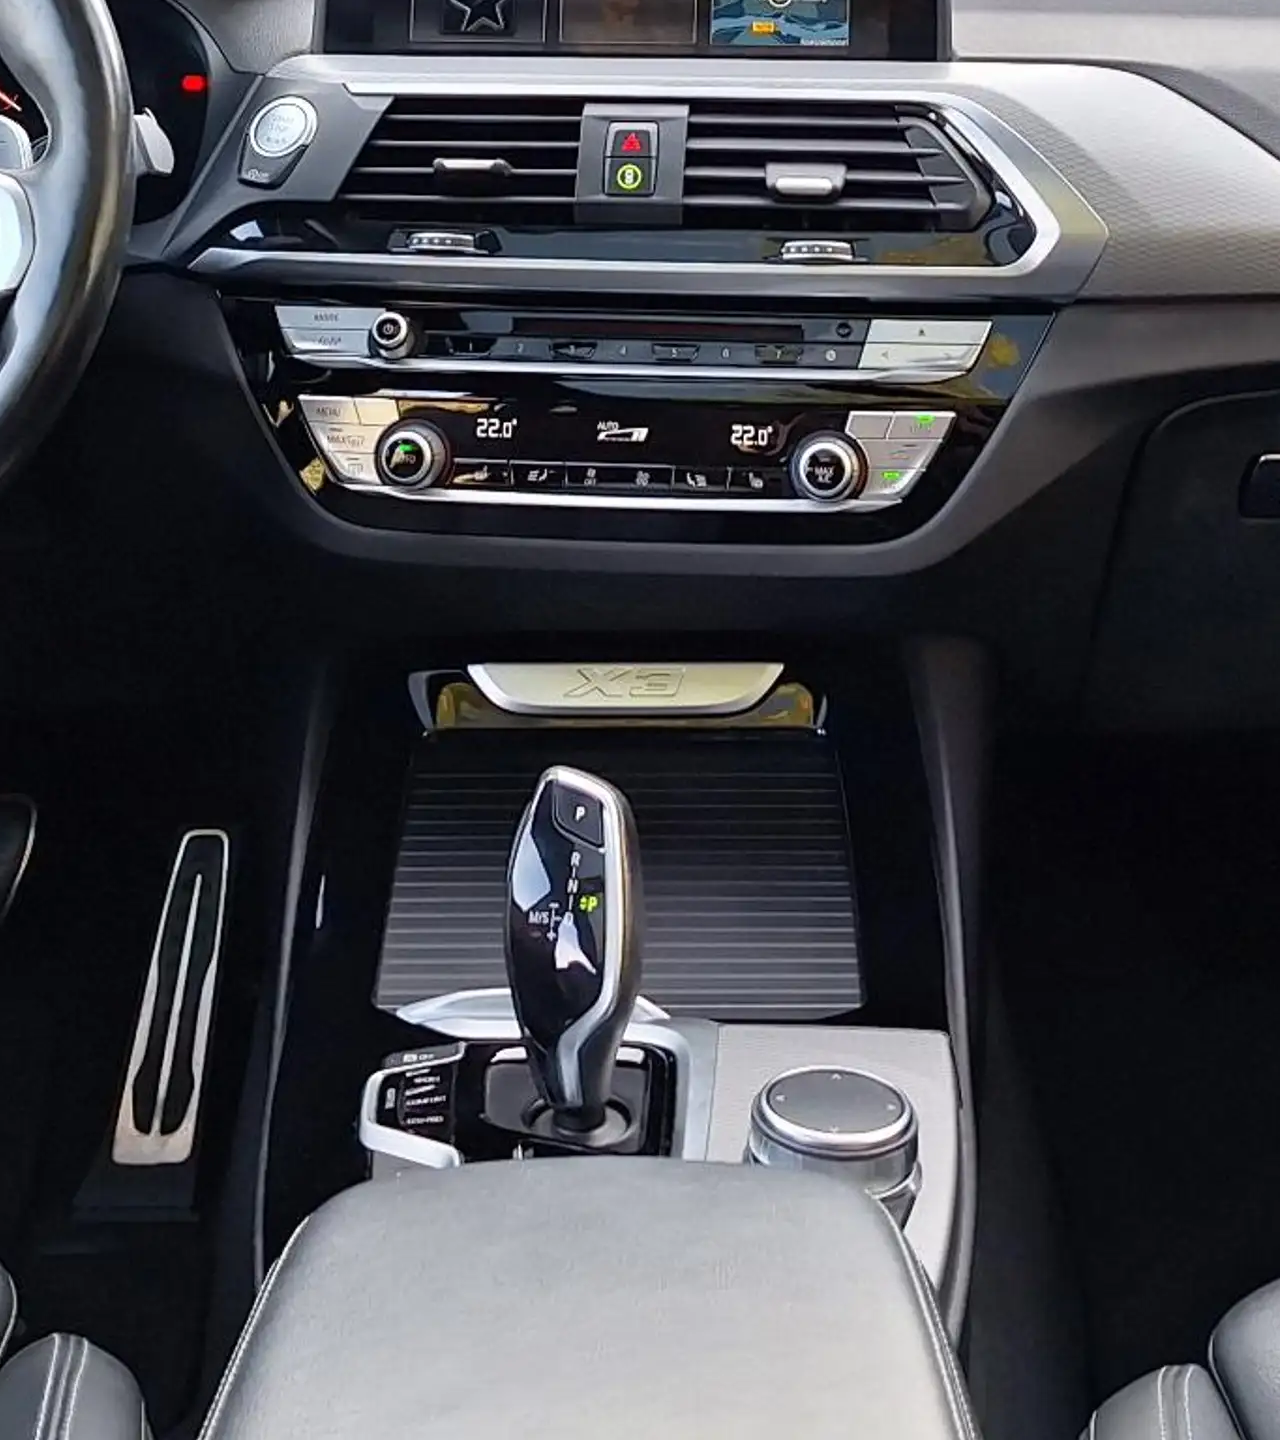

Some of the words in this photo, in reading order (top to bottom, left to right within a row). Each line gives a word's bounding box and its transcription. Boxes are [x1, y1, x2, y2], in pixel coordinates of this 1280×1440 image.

[597, 421, 620, 431] AUTO
[814, 466, 835, 476] MAX
[563, 667, 686, 698] X3
[575, 806, 586, 822] P
[570, 851, 581, 867] R
[567, 878, 578, 894] N
